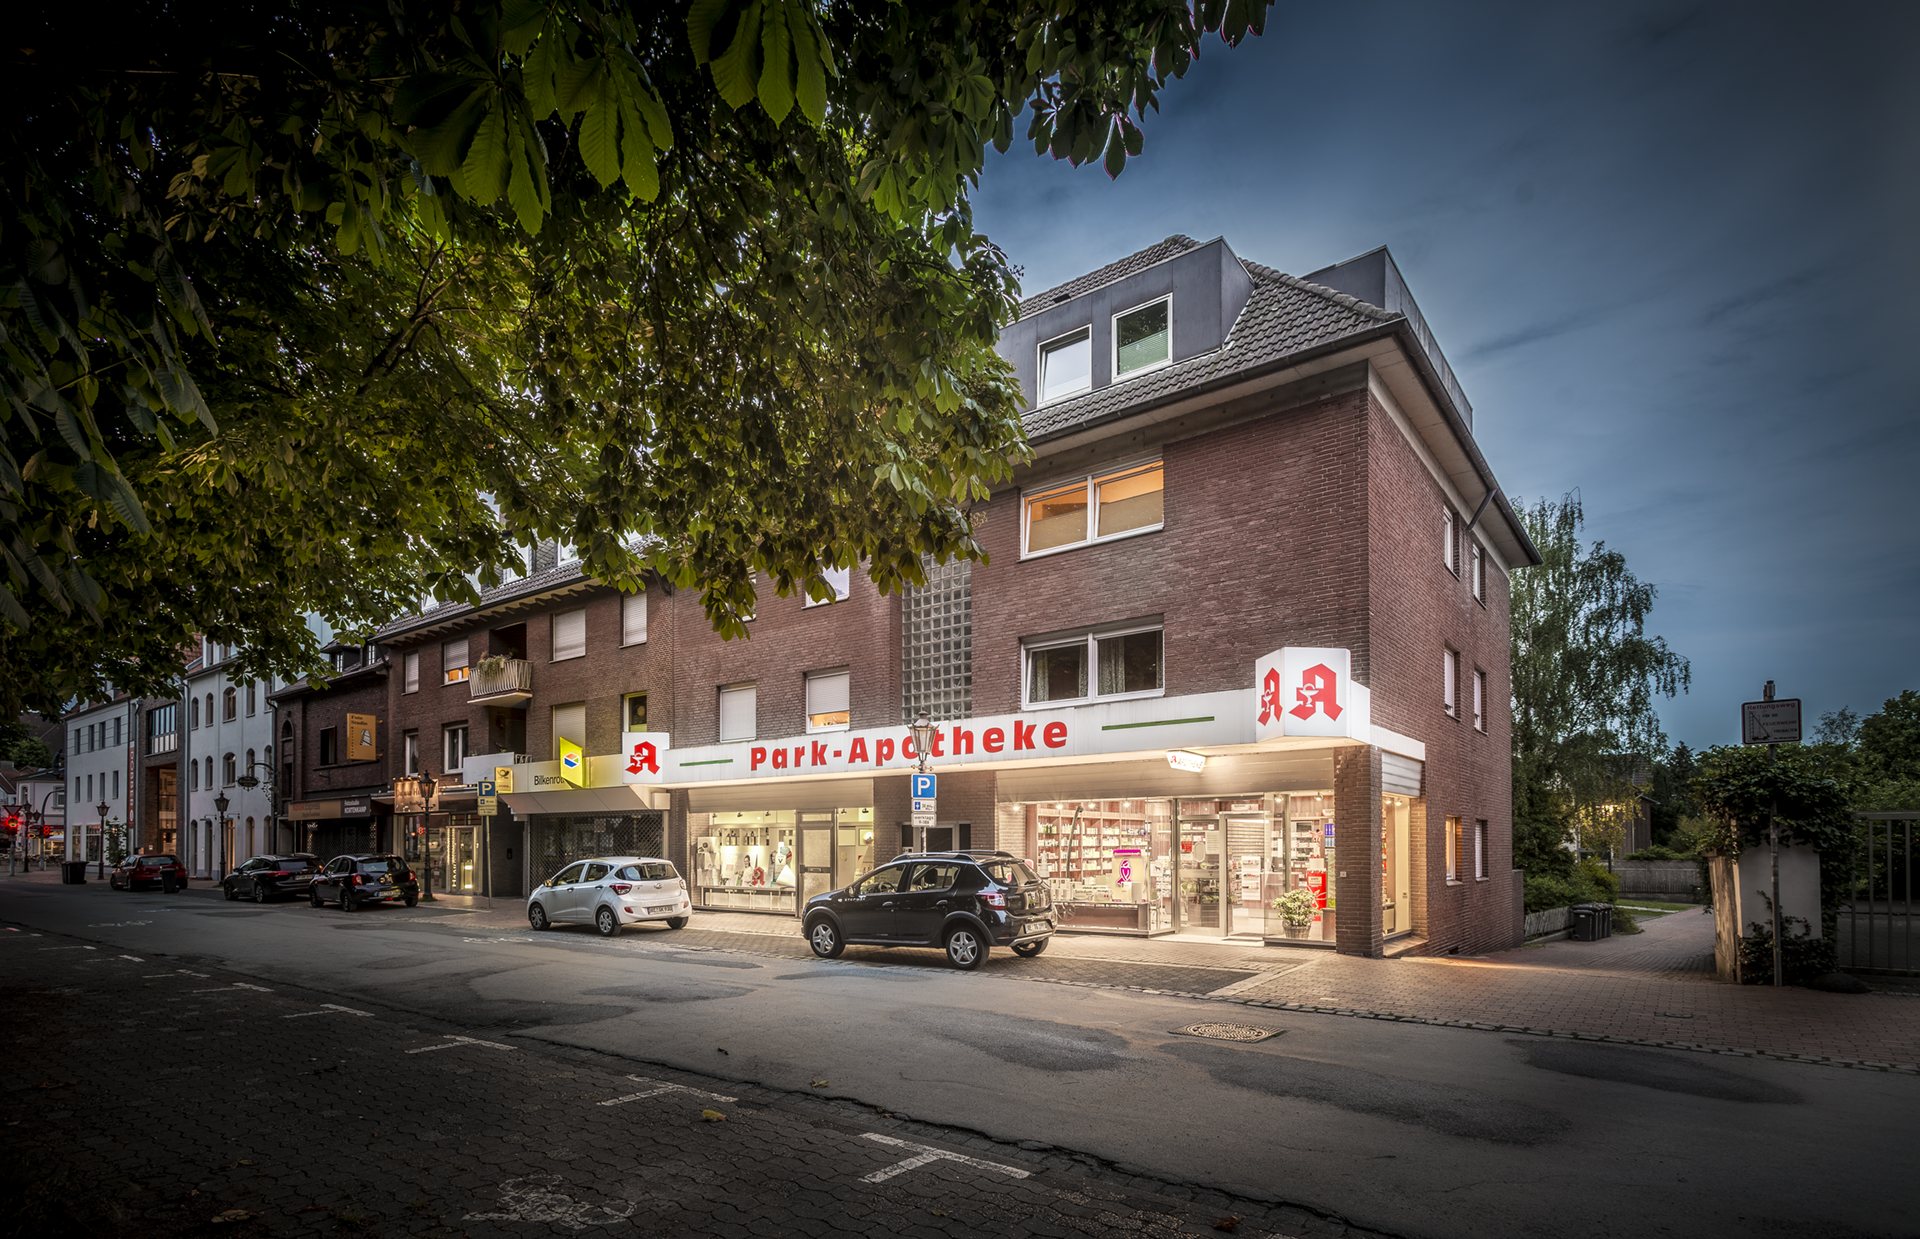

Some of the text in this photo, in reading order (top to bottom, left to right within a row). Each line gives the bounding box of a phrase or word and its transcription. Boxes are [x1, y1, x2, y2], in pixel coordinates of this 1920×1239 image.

[750, 720, 1068, 771] Park-Apotheke
[482, 782, 492, 795] P
[918, 777, 931, 795] P
